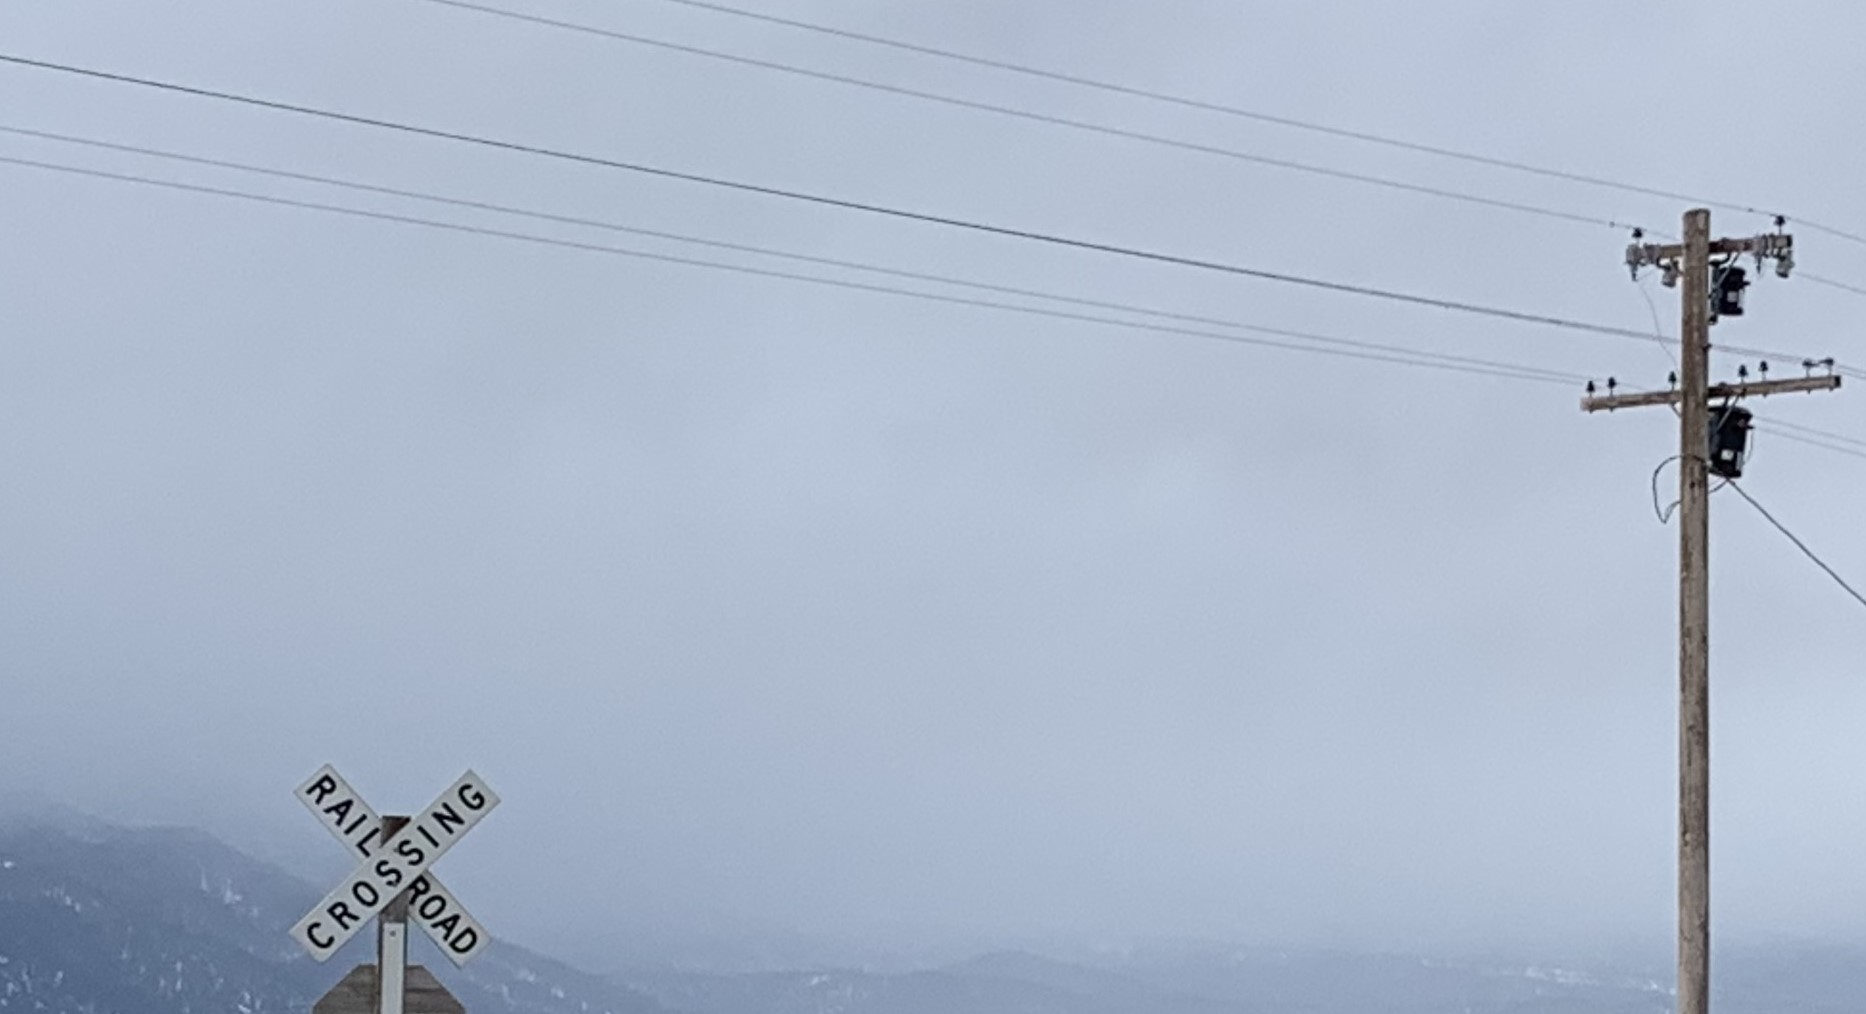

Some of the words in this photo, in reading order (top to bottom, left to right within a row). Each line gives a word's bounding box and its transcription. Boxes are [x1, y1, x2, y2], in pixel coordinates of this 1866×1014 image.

[306, 774, 381, 857] RAIL
[407, 875, 478, 954] ROAD
[307, 784, 485, 949] CROSSING
